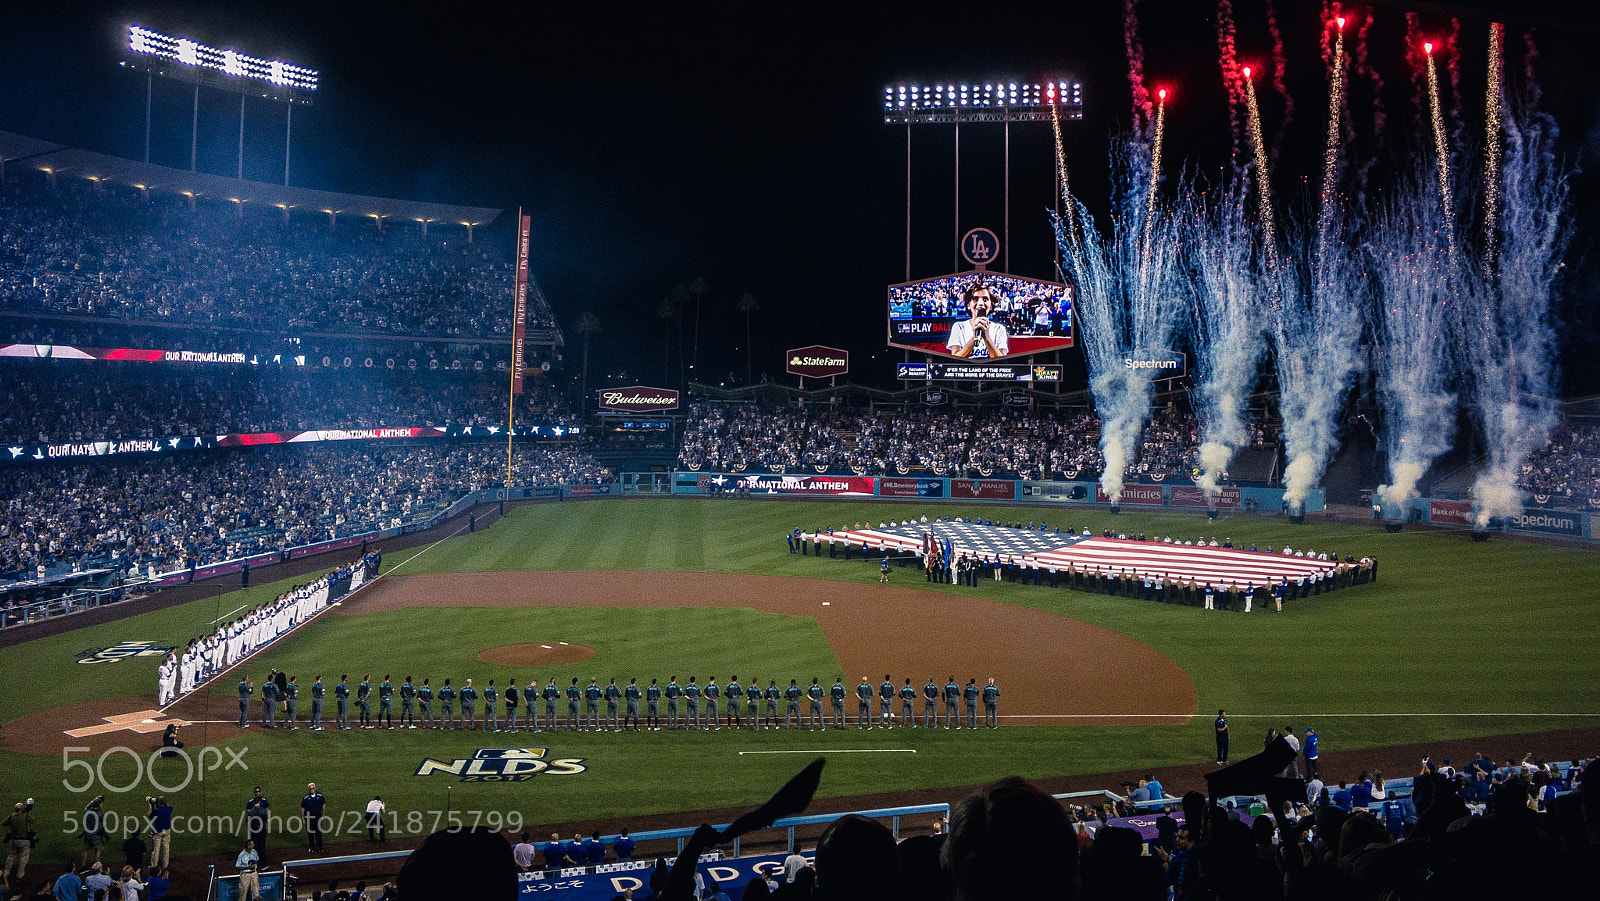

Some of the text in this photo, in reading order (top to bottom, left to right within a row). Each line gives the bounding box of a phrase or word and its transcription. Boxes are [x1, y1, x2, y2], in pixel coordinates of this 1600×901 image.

[971, 234, 989, 259] LA
[911, 323, 933, 333] PLAY
[165, 351, 180, 361] OUR
[1124, 358, 1177, 372] Spectrum
[602, 391, 677, 406] Budweiser
[325, 428, 411, 440] OUR NATIONAL ANTHEM
[48, 444, 68, 457] OUR
[118, 439, 153, 453] ANTHEM
[759, 480, 807, 490] NATIONAL
[809, 481, 849, 491] ANTHEM
[1122, 488, 1161, 499] mirates
[1512, 511, 1575, 530] Spectrum
[416, 757, 588, 776] NLDS
[464, 774, 531, 783] 2017
[521, 879, 585, 894] ようこそ
